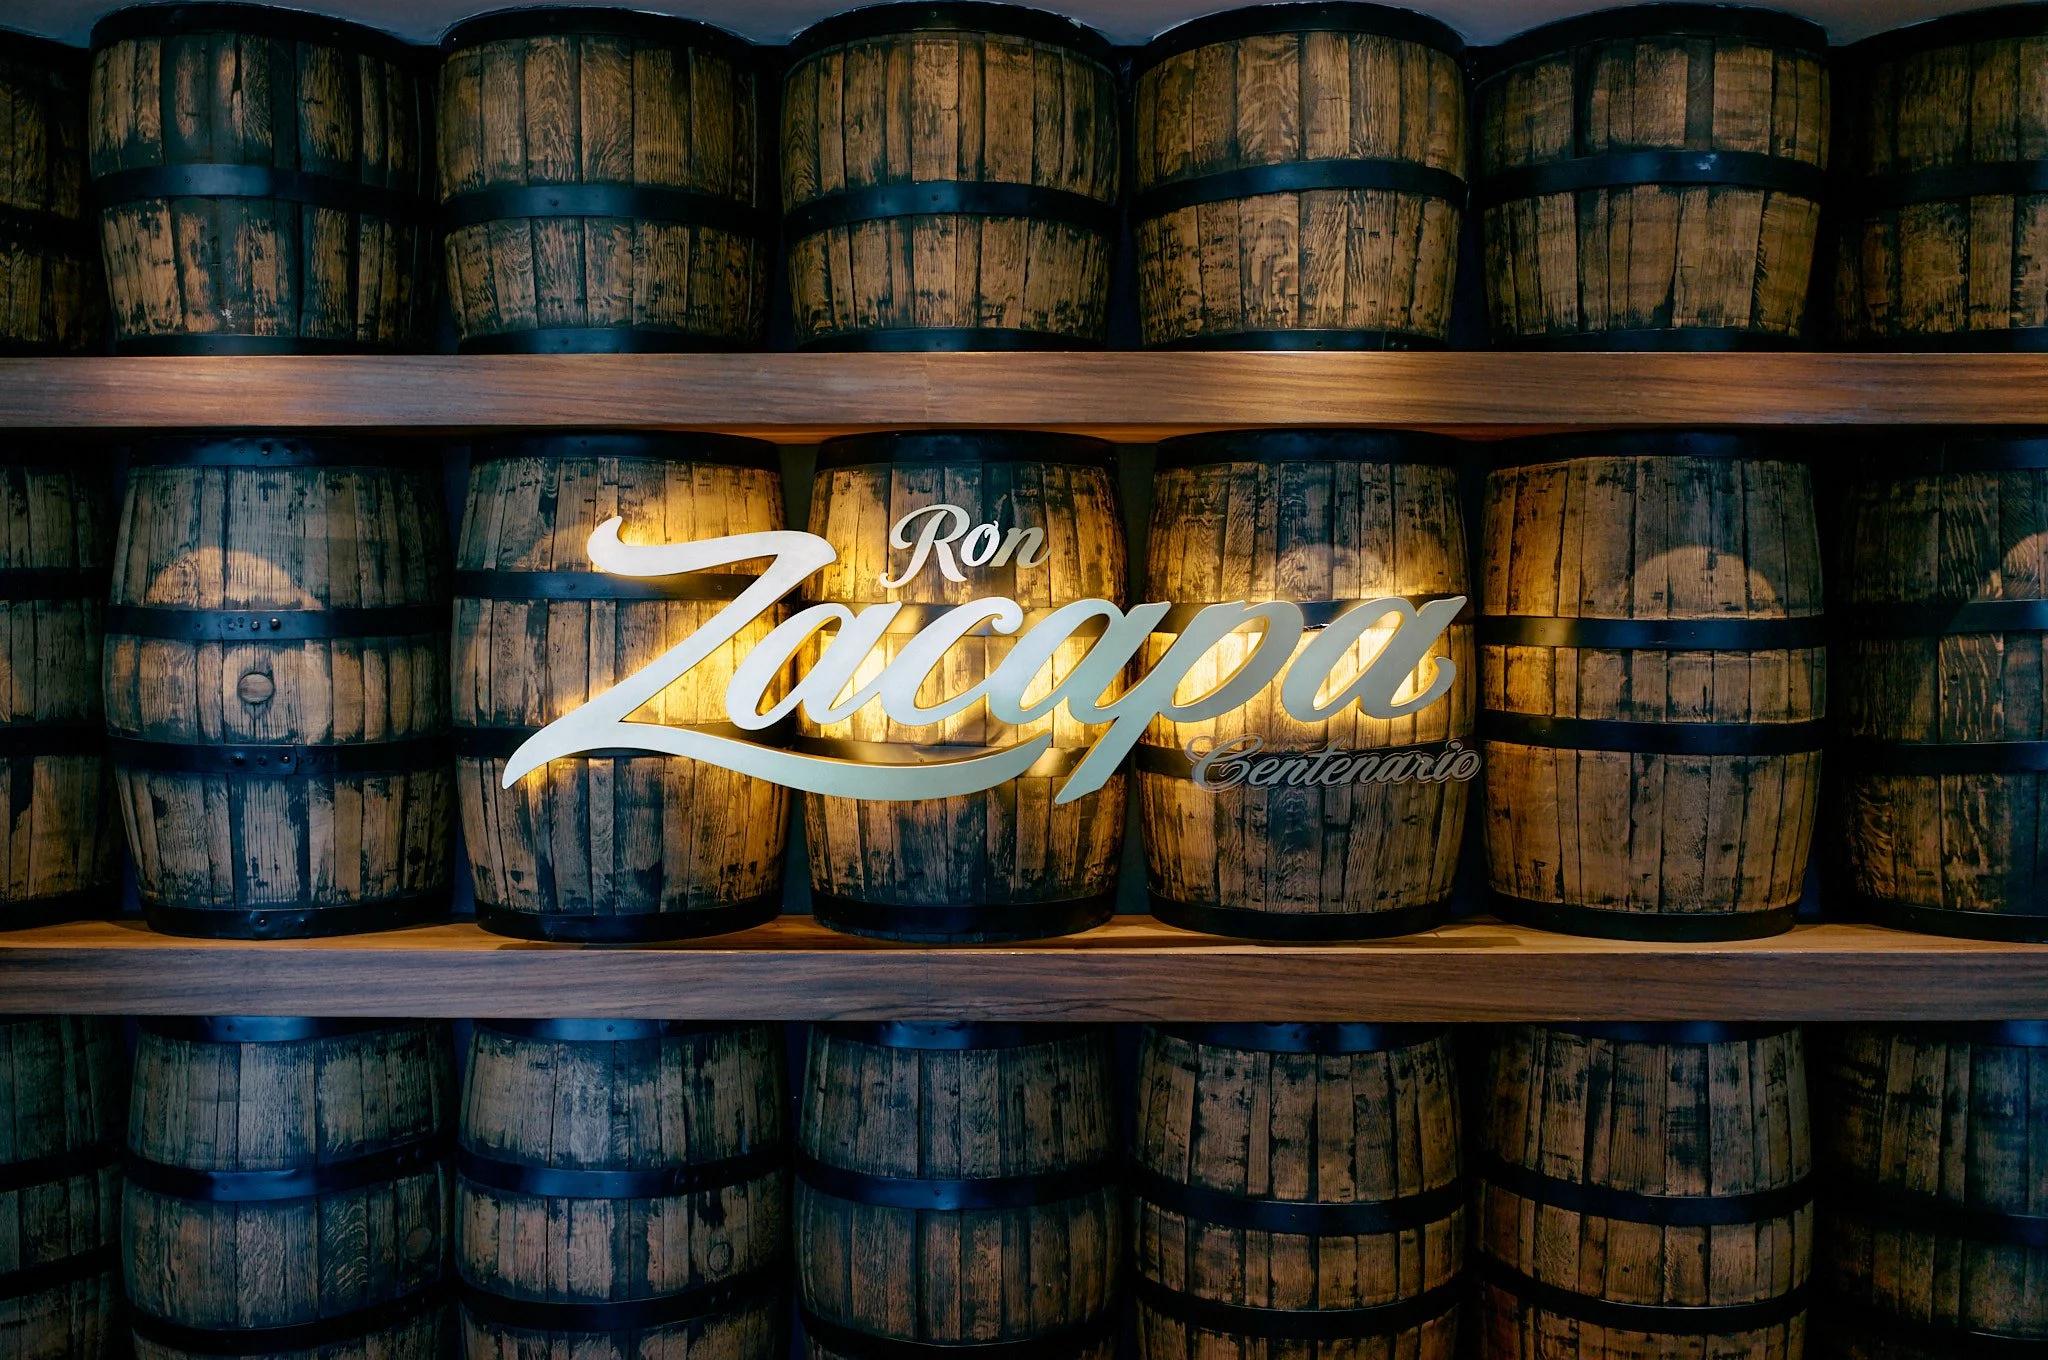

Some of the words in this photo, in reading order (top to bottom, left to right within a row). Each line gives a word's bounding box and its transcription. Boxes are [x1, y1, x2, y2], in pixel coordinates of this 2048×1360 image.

[879, 503, 1051, 589] Ron
[502, 514, 1468, 804] Zacapa
[1184, 734, 1482, 792] Centenario
